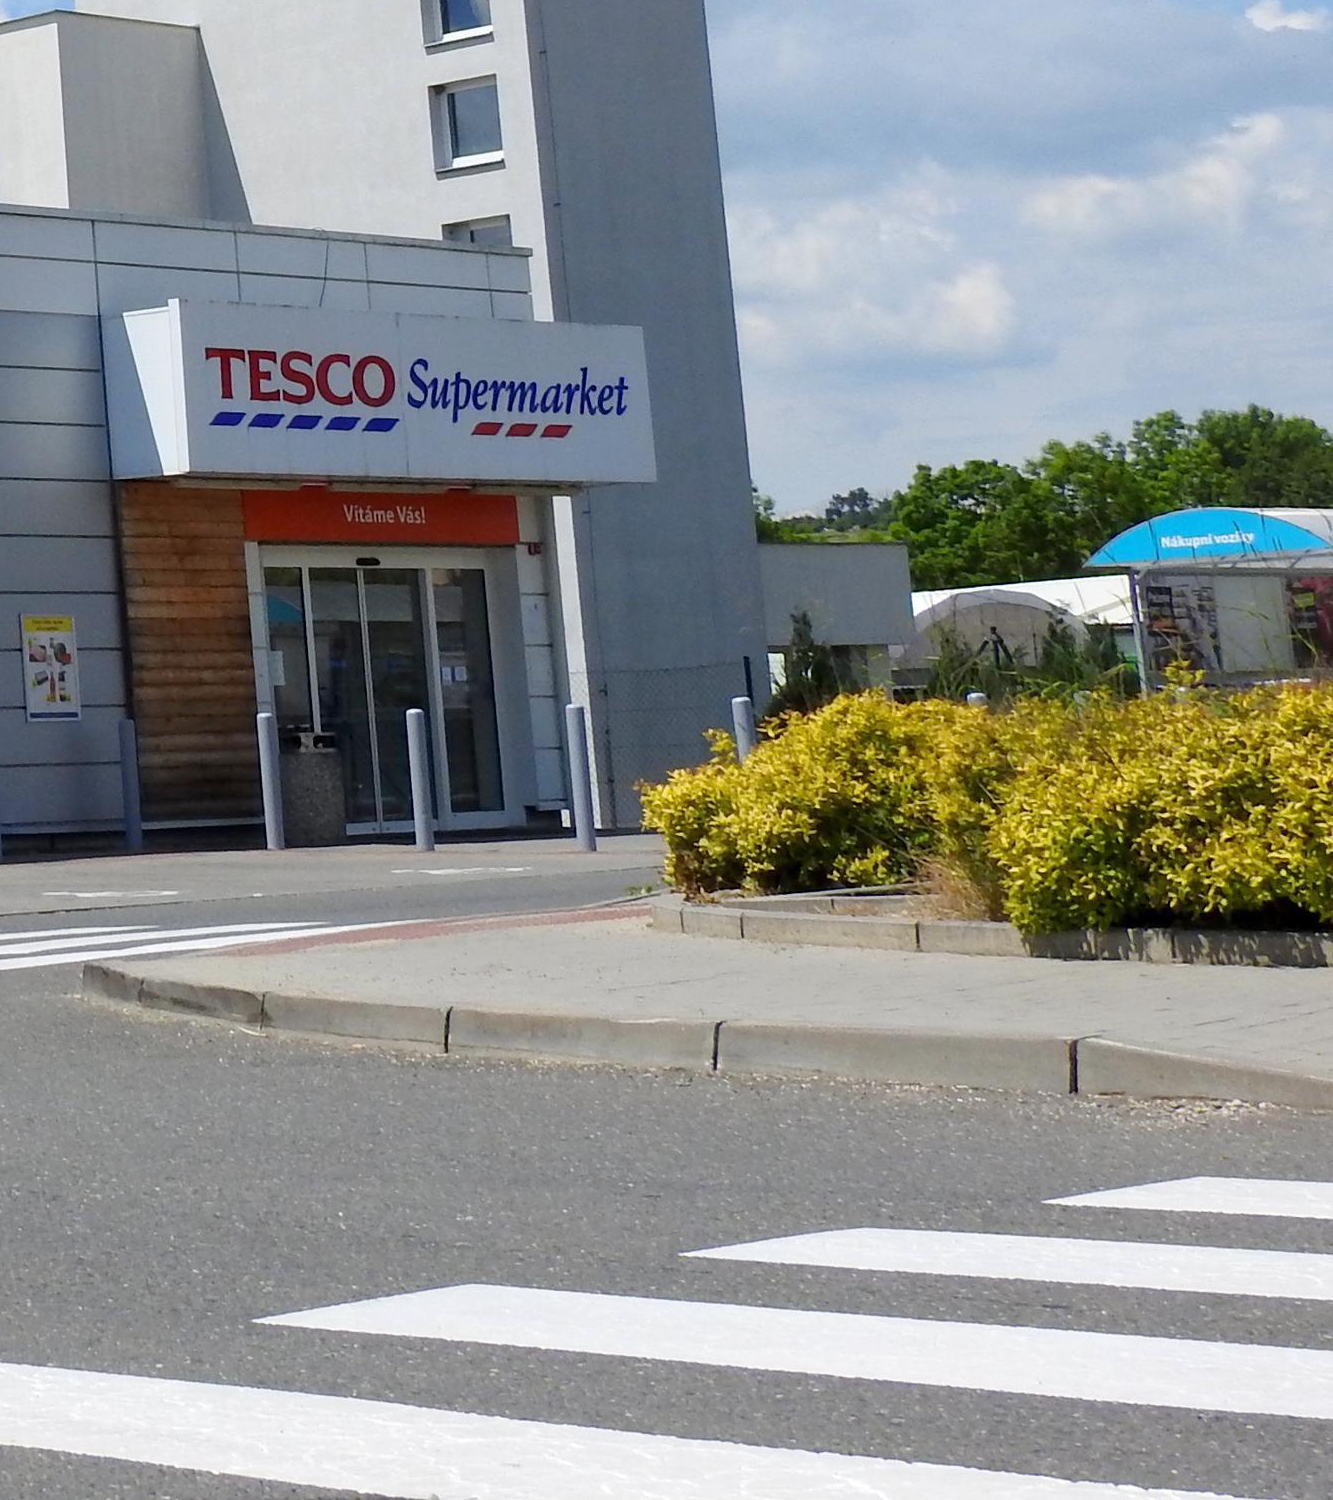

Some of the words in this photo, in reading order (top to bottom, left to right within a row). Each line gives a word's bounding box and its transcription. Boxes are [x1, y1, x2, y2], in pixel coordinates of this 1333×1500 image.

[205, 347, 396, 407] TESCO
[406, 358, 629, 423] Supermarket
[343, 504, 395, 523] Vítáme
[396, 505, 426, 524] Vás!
